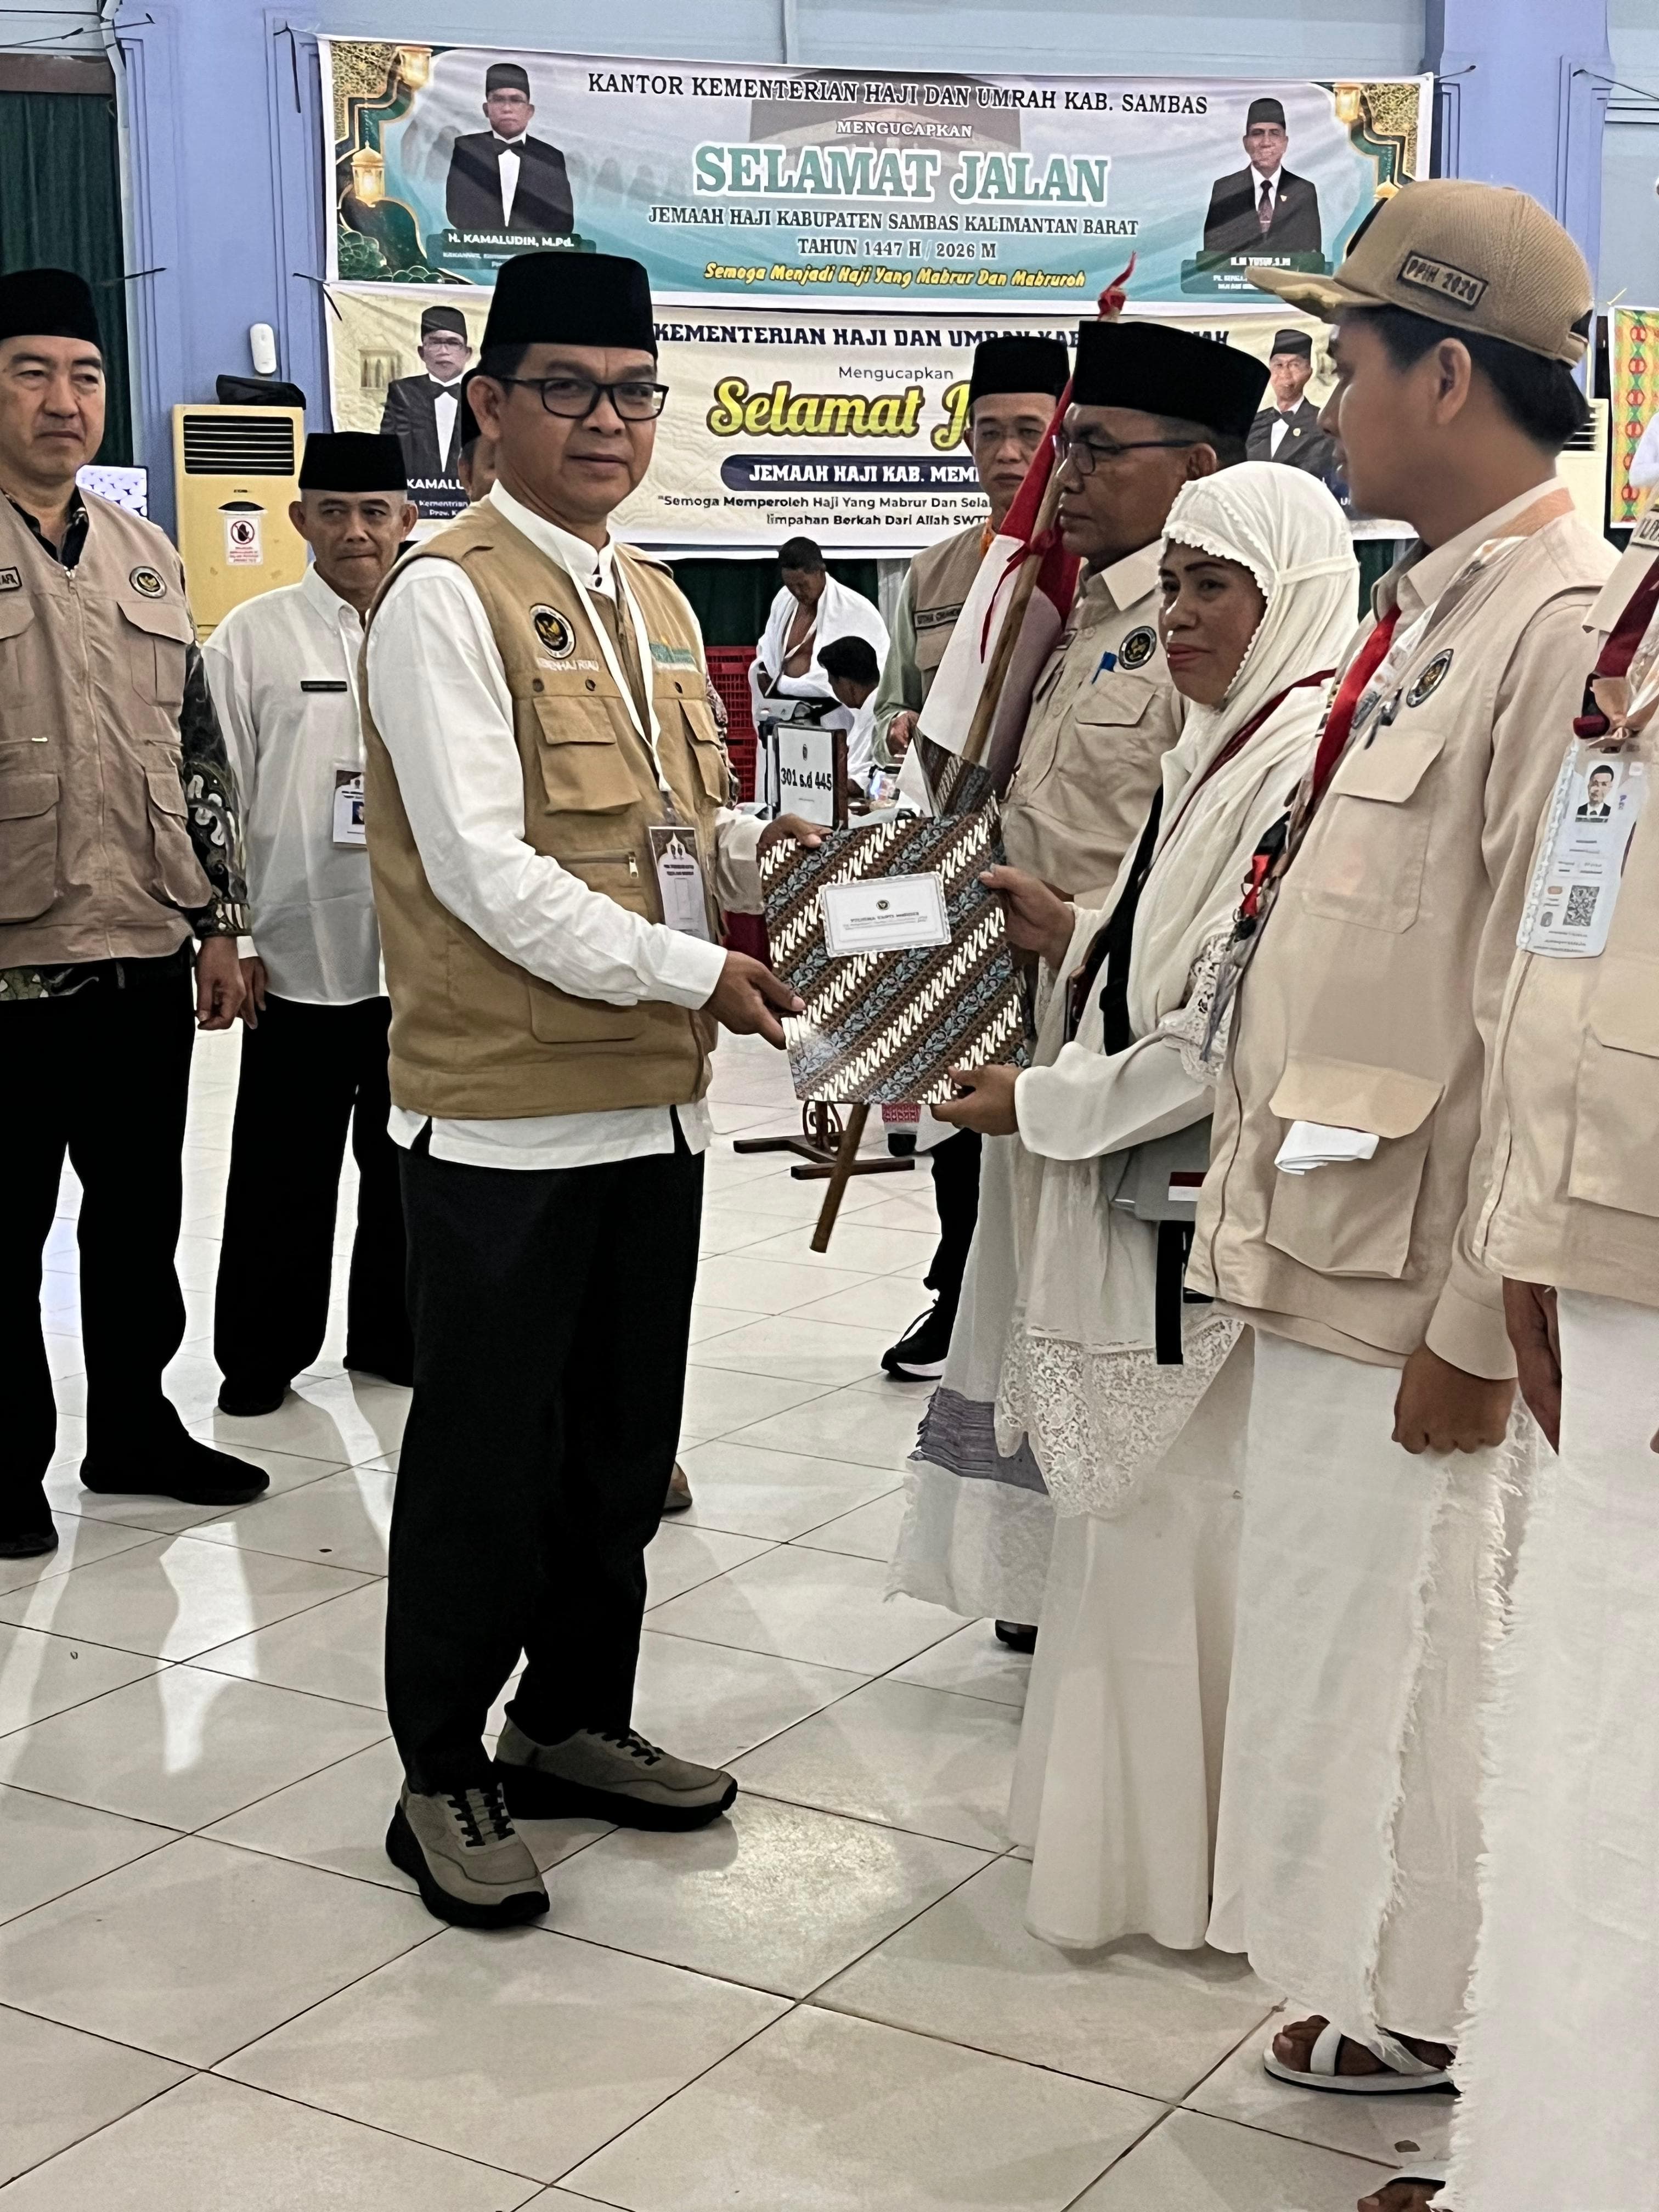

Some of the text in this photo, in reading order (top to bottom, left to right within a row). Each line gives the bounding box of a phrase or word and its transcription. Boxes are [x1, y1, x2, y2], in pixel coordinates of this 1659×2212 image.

[589, 73, 1207, 114] KANTOR KEMENTERIAN HAJI DAN UMRAH KAB. SAMBAS
[836, 120, 972, 138] MENGUCAPKAN
[693, 143, 1108, 202] SELAMAT JALAN
[648, 206, 1138, 235] JEMAAH HAJI KABUPATEN SAMBAS KALIMANTAN BARAT
[463, 234, 539, 247] KAMALUDIN,
[797, 238, 857, 255] TAHUN
[864, 241, 902, 256] 1447
[909, 241, 921, 257] H
[936, 243, 975, 258] 2026
[981, 243, 996, 258] M
[705, 262, 1086, 289] Semoga Menjadi Haji Yang Mabrur Dan Mabruroh
[653, 323, 826, 345] KEMENTERIAN
[833, 328, 887, 346] HAJI
[894, 329, 943, 347] DAN
[839, 366, 954, 381] Mengucapkan
[707, 377, 924, 437] Selamat
[749, 465, 827, 482] JEMAAH
[834, 465, 877, 482] HAJI
[882, 465, 924, 482] KAB.
[723, 496, 809, 509] Memperoleh
[813, 496, 839, 509] Haji
[842, 496, 875, 509] Yang
[879, 498, 927, 507] Mabrur
[931, 498, 957, 507] Dan
[767, 514, 829, 527] limpahan
[833, 515, 881, 525] Berkah
[885, 514, 912, 525] Dari
[916, 515, 950, 525] Allah
[780, 768, 798, 787] 301
[815, 771, 832, 792] 445
